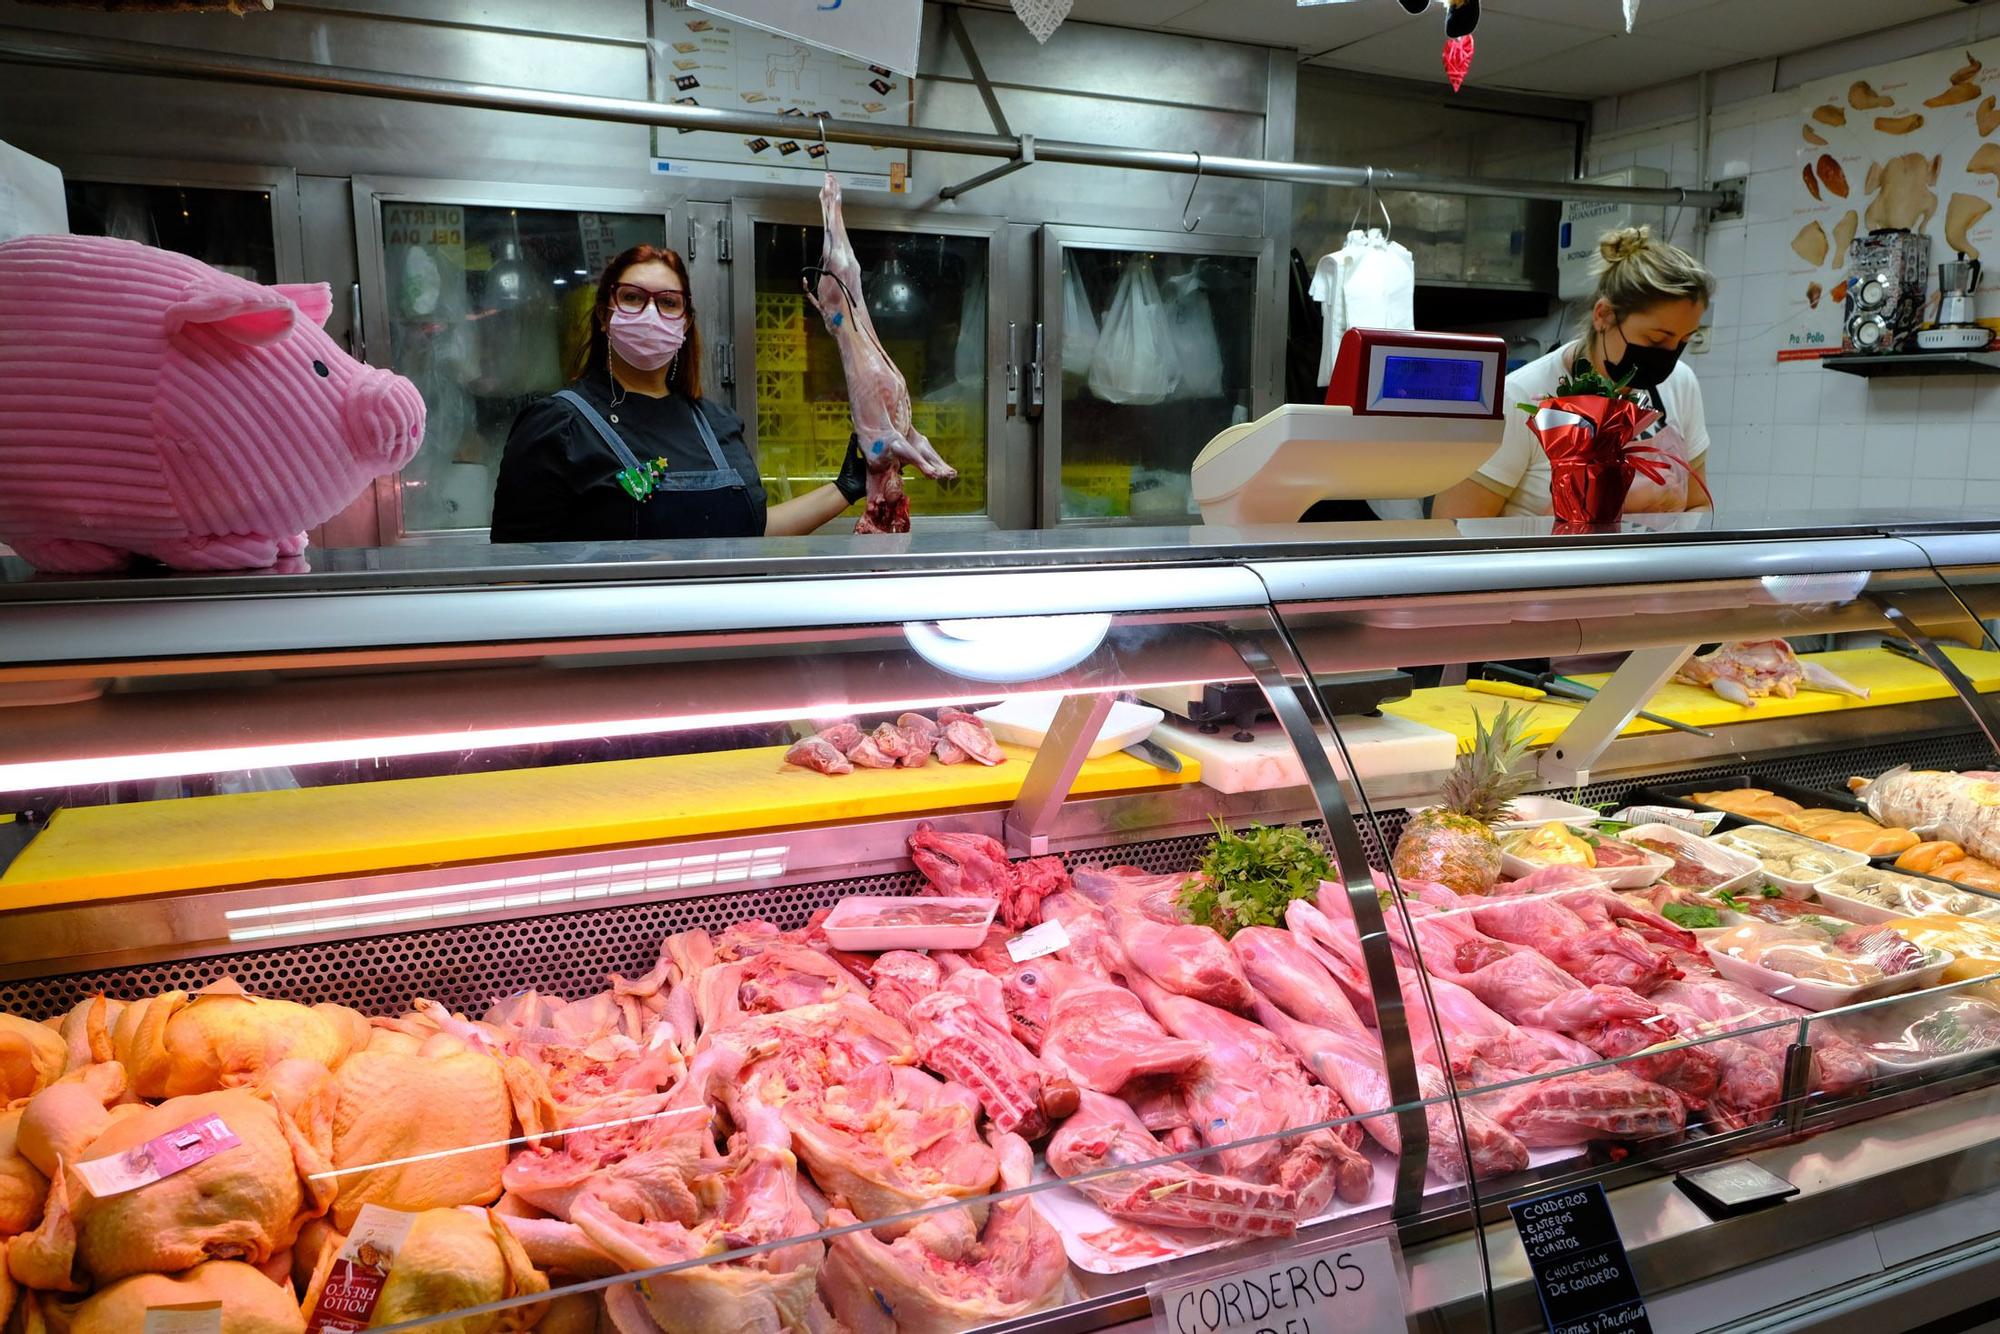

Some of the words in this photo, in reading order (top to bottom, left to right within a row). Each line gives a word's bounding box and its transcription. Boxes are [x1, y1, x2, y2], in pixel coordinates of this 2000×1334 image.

[1806, 331, 1825, 344] Pollo
[1523, 1192, 1588, 1220] CORDEROS
[1545, 1253, 1609, 1282] CHULETILLAS
[325, 1283, 377, 1301] FRESCO
[1176, 1253, 1364, 1334] CORDEROS
[1546, 1282, 1568, 1297] DE
[1569, 1267, 1620, 1292] CORDERO
[323, 1296, 369, 1313] POLLO
